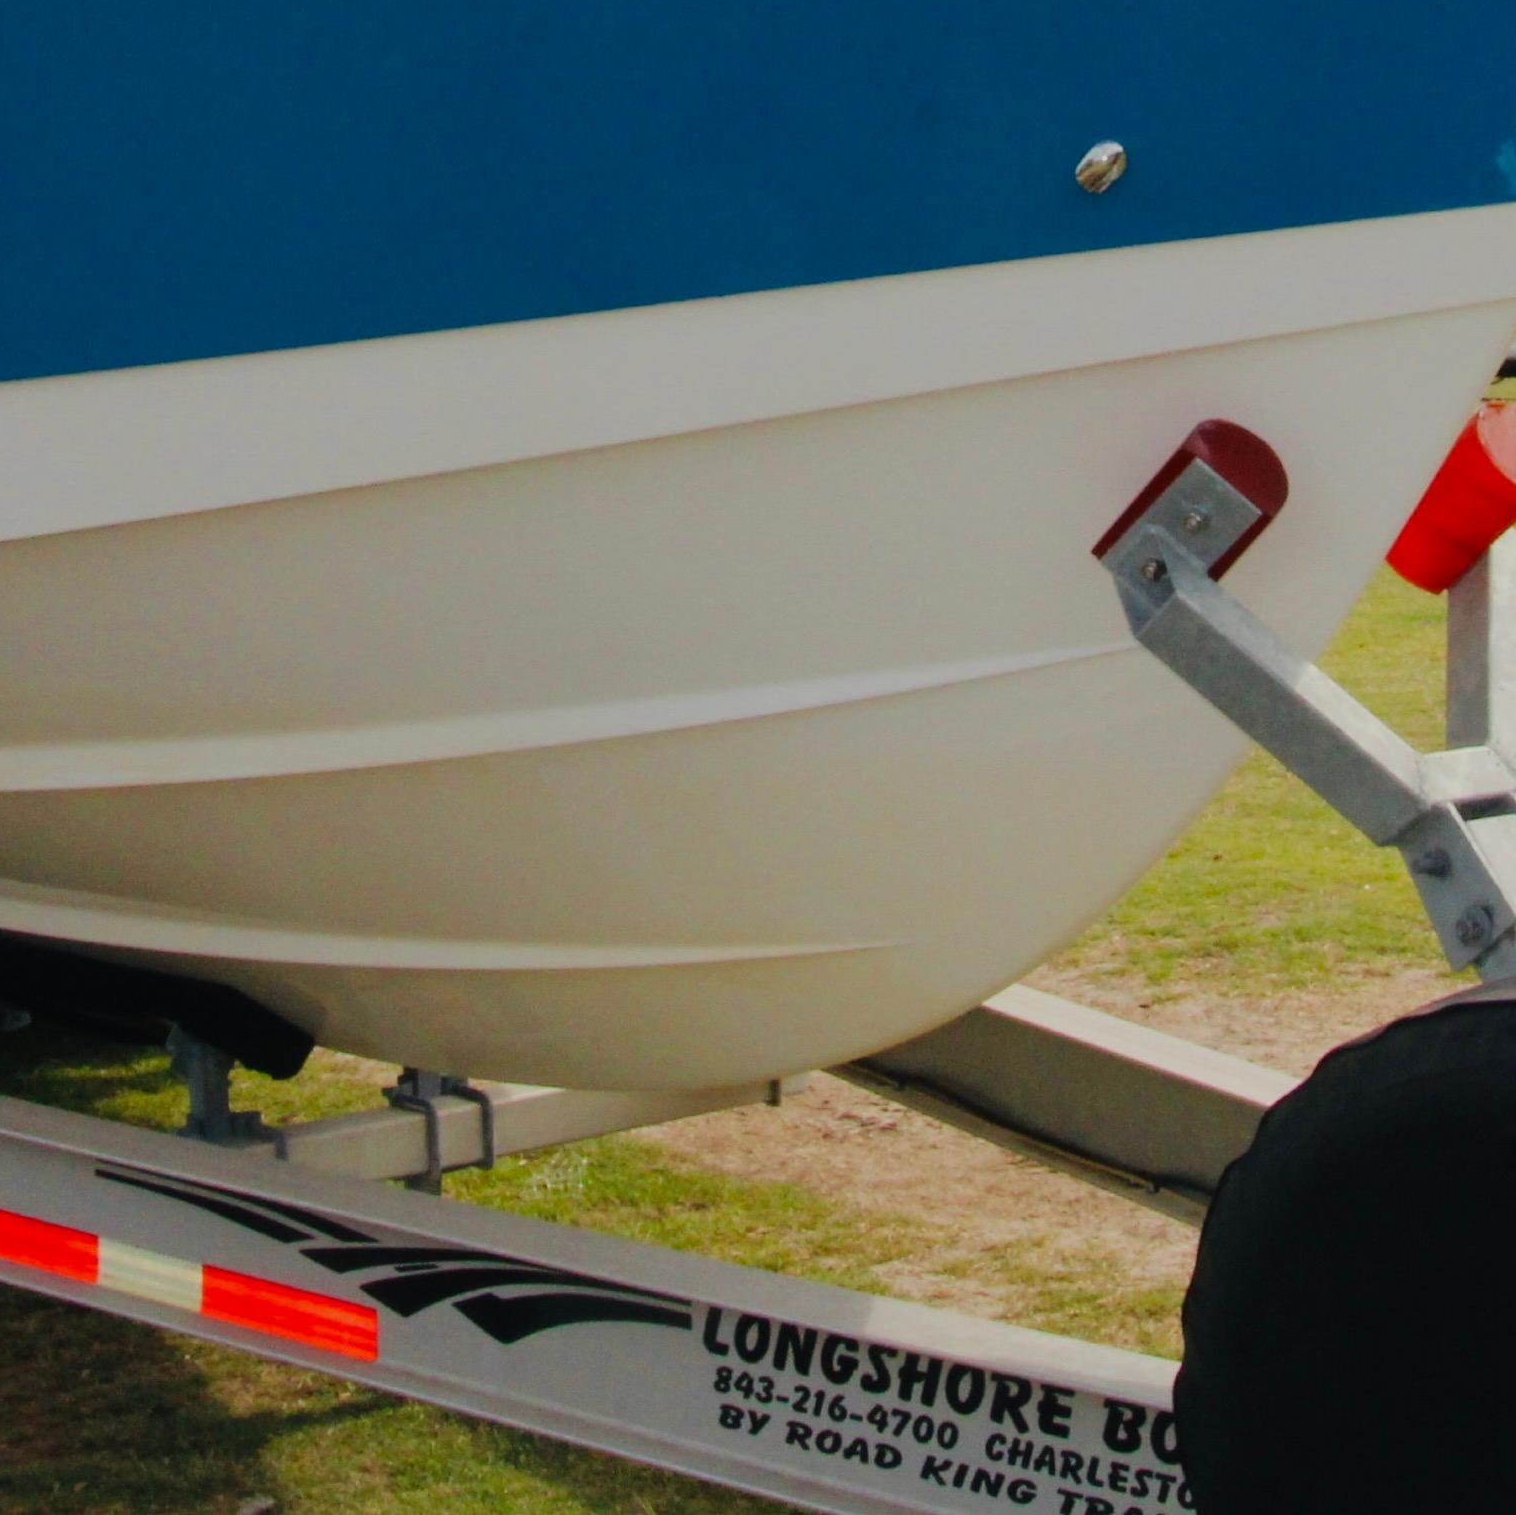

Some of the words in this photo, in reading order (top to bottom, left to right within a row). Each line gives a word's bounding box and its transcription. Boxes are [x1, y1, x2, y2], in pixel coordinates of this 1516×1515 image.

[703, 1306, 1076, 1438] LONGSHORE
[713, 1366, 959, 1450] 843-216-4700
[718, 1403, 770, 1435] BY
[785, 1420, 902, 1469] ROAD
[919, 1455, 1037, 1504] KING
